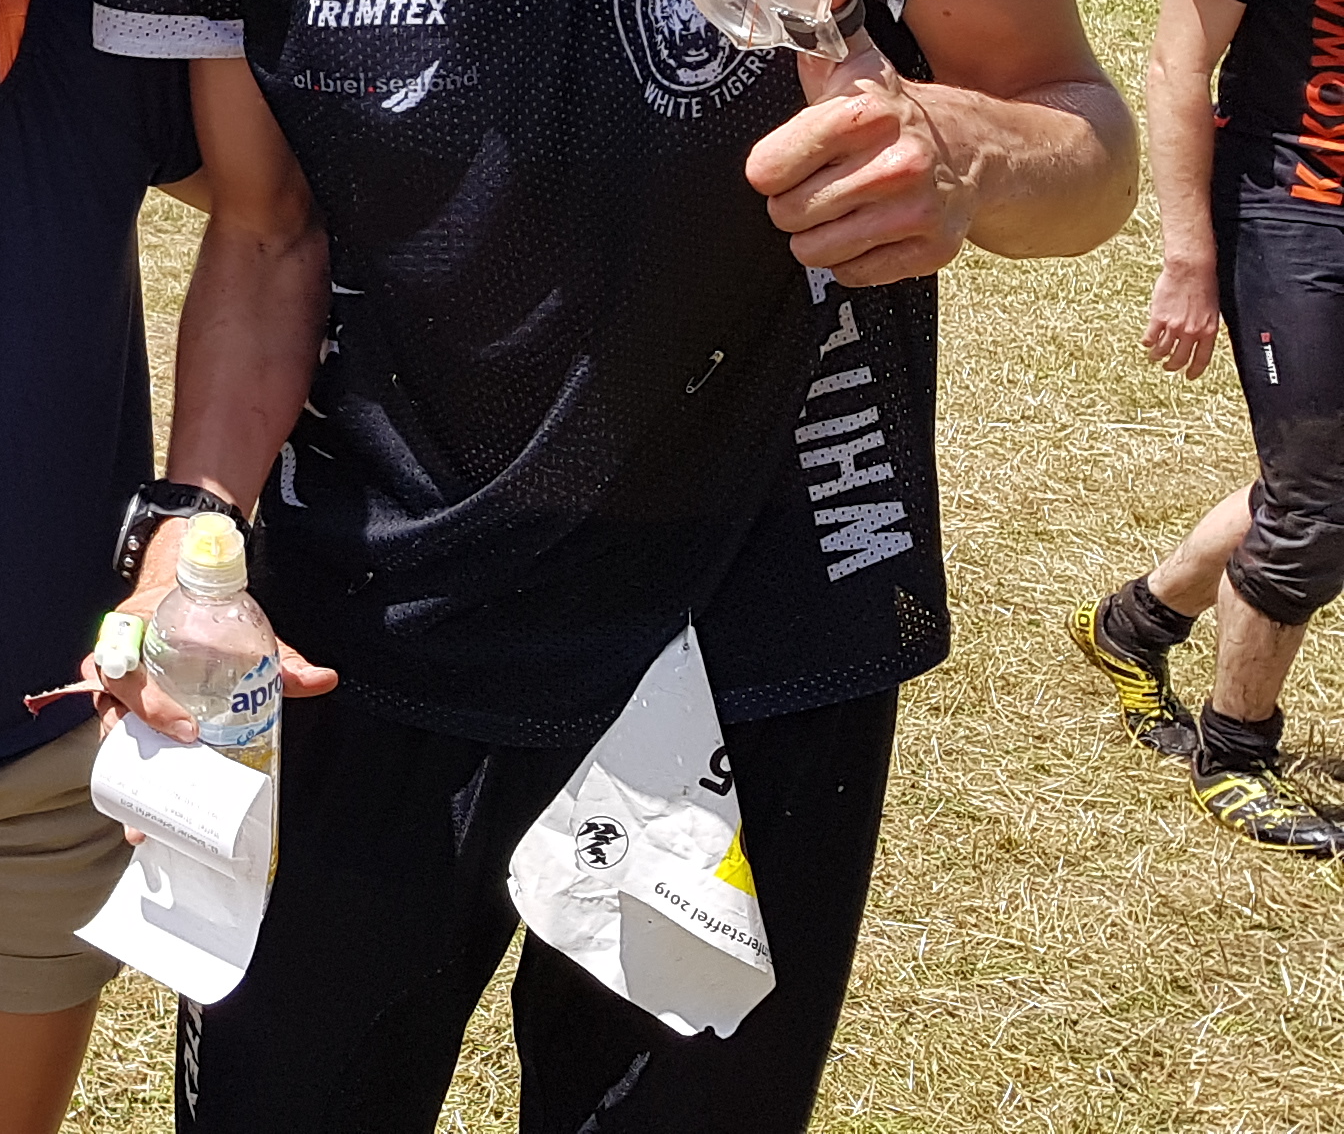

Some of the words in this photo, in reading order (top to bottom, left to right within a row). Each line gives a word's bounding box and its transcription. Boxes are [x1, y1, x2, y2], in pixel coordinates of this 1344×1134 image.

[643, 79, 703, 120] WHITE
[710, 47, 777, 109] TIGERS
[654, 881, 691, 913] 2019
